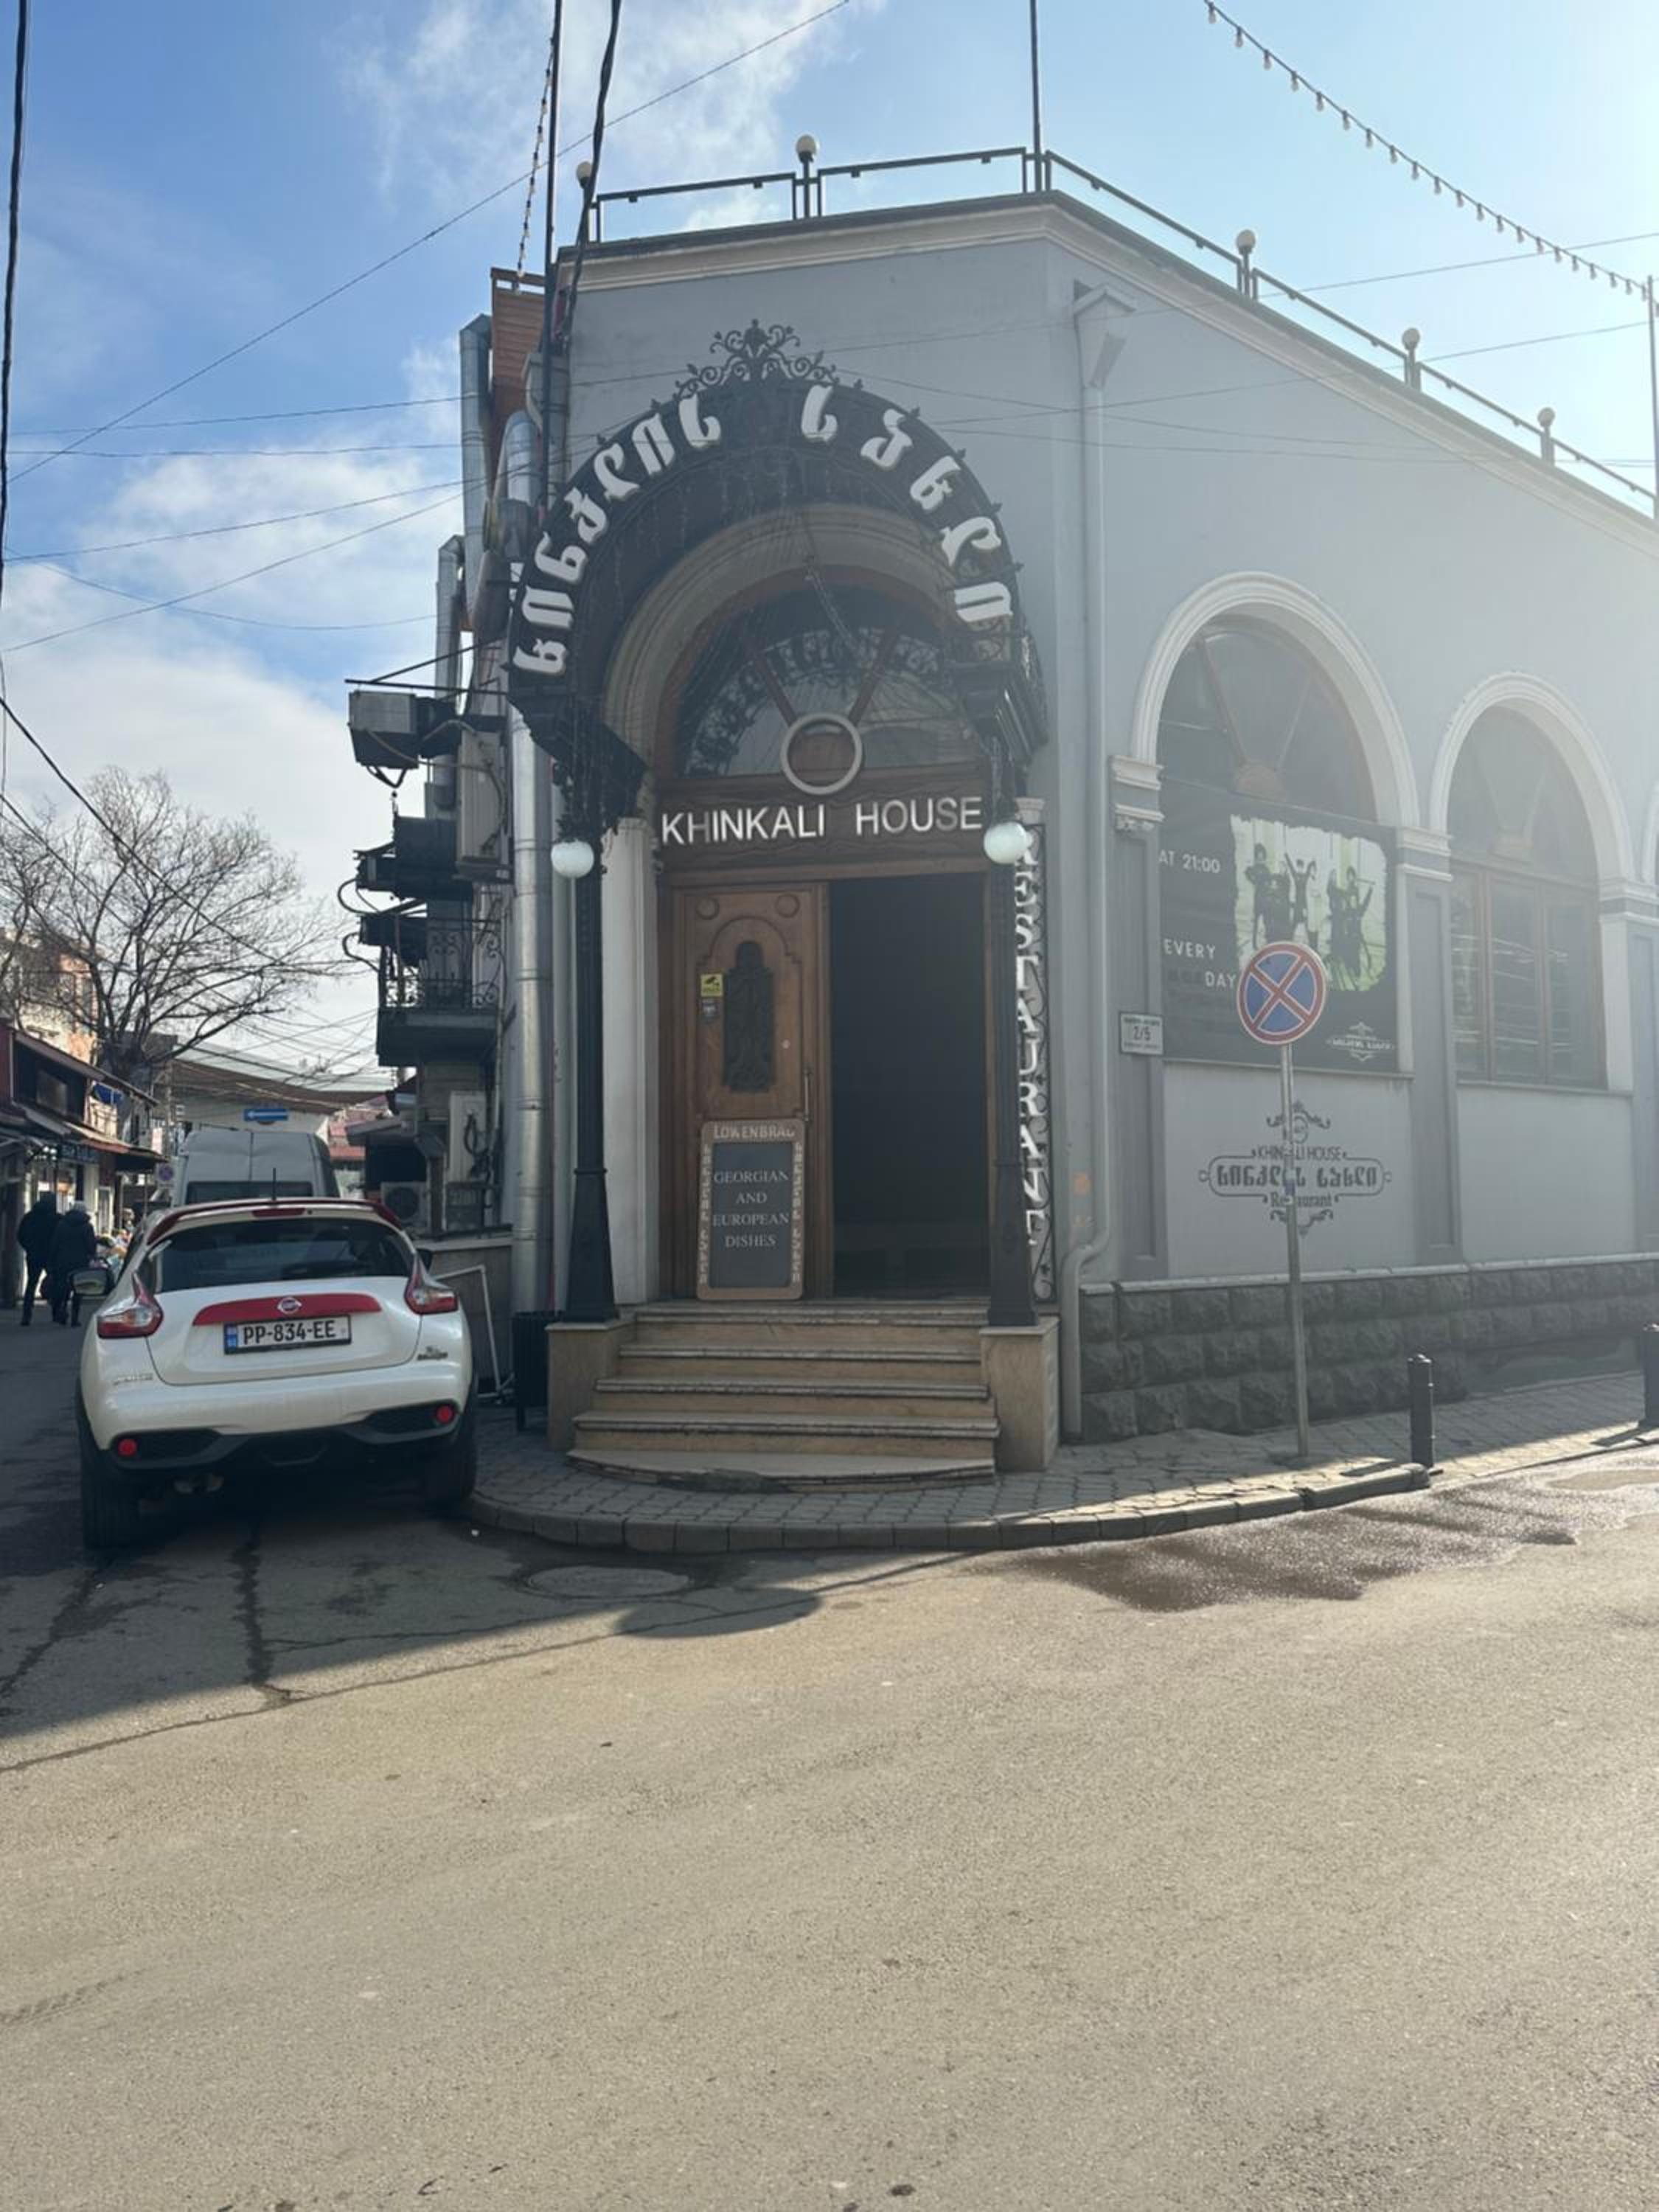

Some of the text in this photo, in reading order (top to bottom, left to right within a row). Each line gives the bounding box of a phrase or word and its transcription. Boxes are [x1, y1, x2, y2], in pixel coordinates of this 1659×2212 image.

[800, 384, 1014, 622] სახლი
[661, 797, 983, 845] KHINKALI HOUSE
[1158, 849, 1221, 874] AT 21:00
[1163, 939, 1217, 960] EVERY
[1205, 971, 1237, 989] DAY
[713, 1170, 789, 1183] GEORGIAN
[736, 1192, 768, 1204] AND
[712, 1212, 789, 1227] EUROPEAN
[725, 1234, 776, 1248] DISHES
[243, 1319, 336, 1345] PP-834-EE
